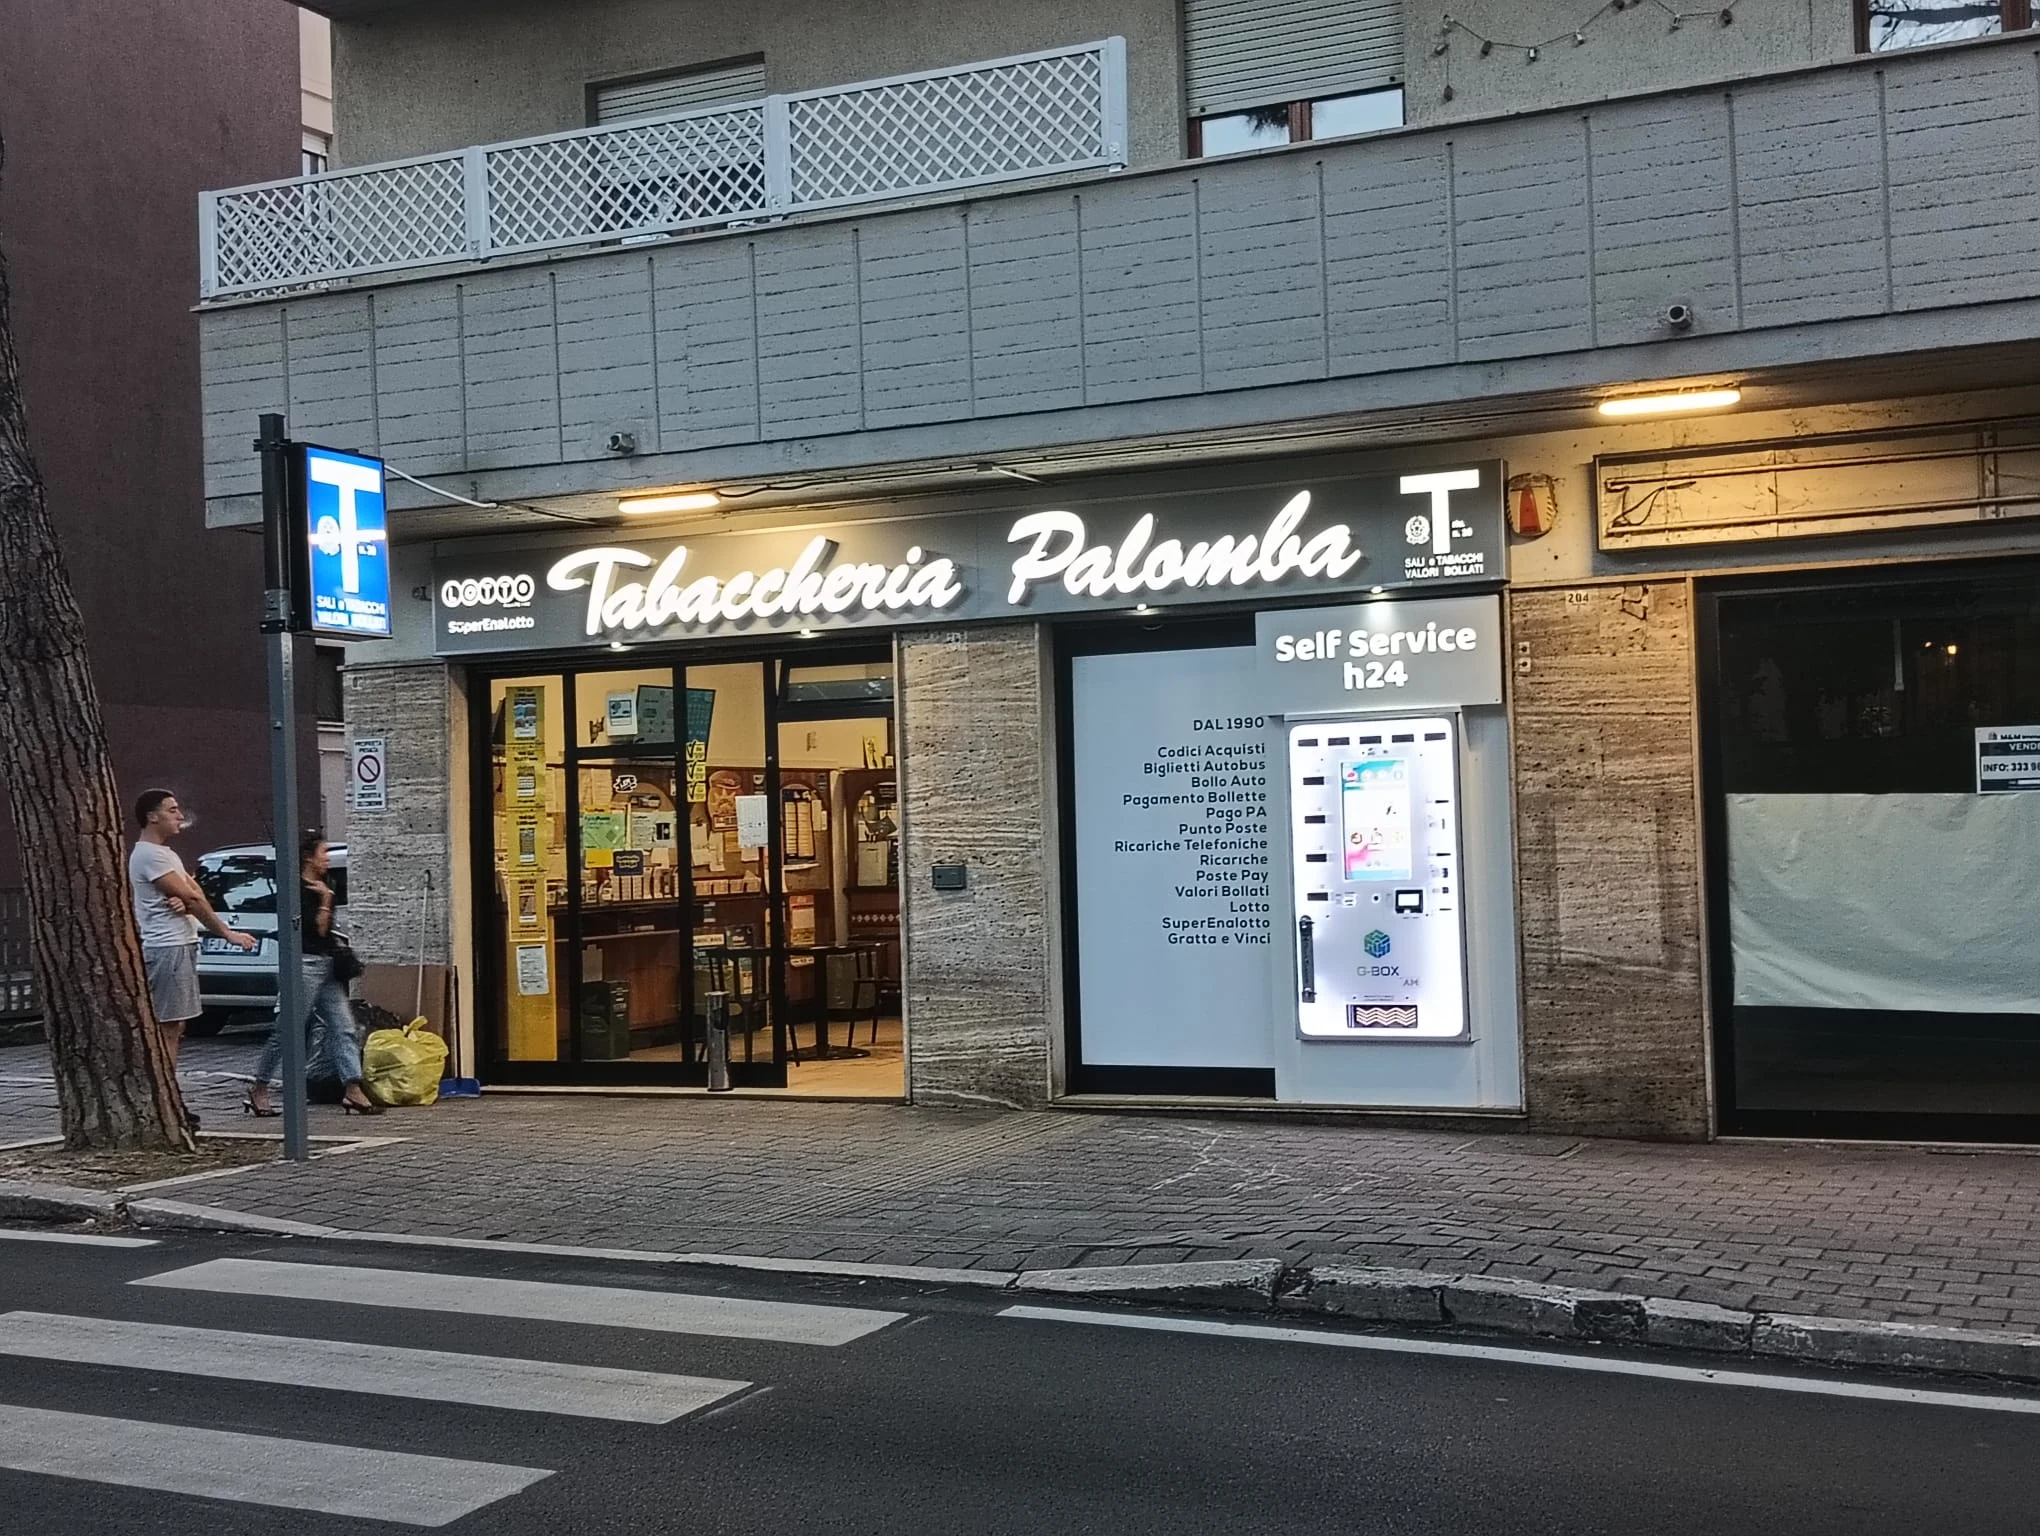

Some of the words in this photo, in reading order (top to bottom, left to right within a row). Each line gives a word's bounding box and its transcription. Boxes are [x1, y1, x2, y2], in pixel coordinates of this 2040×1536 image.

[1400, 469, 1480, 554] T
[1007, 490, 1363, 605] Palomba
[1405, 557, 1425, 568] SALI
[1436, 552, 1483, 566] TABACCHI
[1405, 567, 1439, 579] VALORI
[1444, 564, 1484, 577] BOLLATI
[442, 574, 535, 608] LOTTO
[546, 535, 963, 636] Tabaccheria
[1275, 629, 1342, 662] Self
[1349, 621, 1477, 657] Service
[1343, 660, 1408, 690] h24
[1193, 719, 1224, 731] DAL
[1226, 717, 1264, 730] 1990
[1157, 745, 1201, 758] Codici
[1204, 742, 1265, 758] Acquisti
[1144, 761, 1200, 777] Biglietti
[1203, 760, 1266, 772] Autobus
[1983, 763, 2009, 772] INFO:
[2011, 762, 2029, 772] 333
[1191, 776, 1227, 788] Bollo
[1230, 775, 1266, 787] Auto
[1123, 793, 1205, 809] Pagamento
[1208, 791, 1267, 803] Bollette
[1206, 807, 1242, 822] Pago
[1246, 806, 1267, 818] PA
[1179, 824, 1222, 835] Punto
[1225, 823, 1268, 834] Poste
[1114, 840, 1181, 852] Ricariche
[1183, 838, 1268, 850] Telefoniche
[1200, 853, 1268, 866] Ricariche
[1196, 870, 1238, 882] Poste
[1241, 869, 1269, 883] Pay
[1175, 885, 1218, 897] Valori
[1221, 885, 1269, 897] Bollati
[1230, 901, 1270, 913] Lotto
[1162, 917, 1271, 931] SuperEnalotto
[1167, 933, 1217, 945] Gratta
[1221, 935, 1230, 944] e
[1234, 932, 1271, 945] Vinci
[1356, 965, 1400, 977] G-BOX
